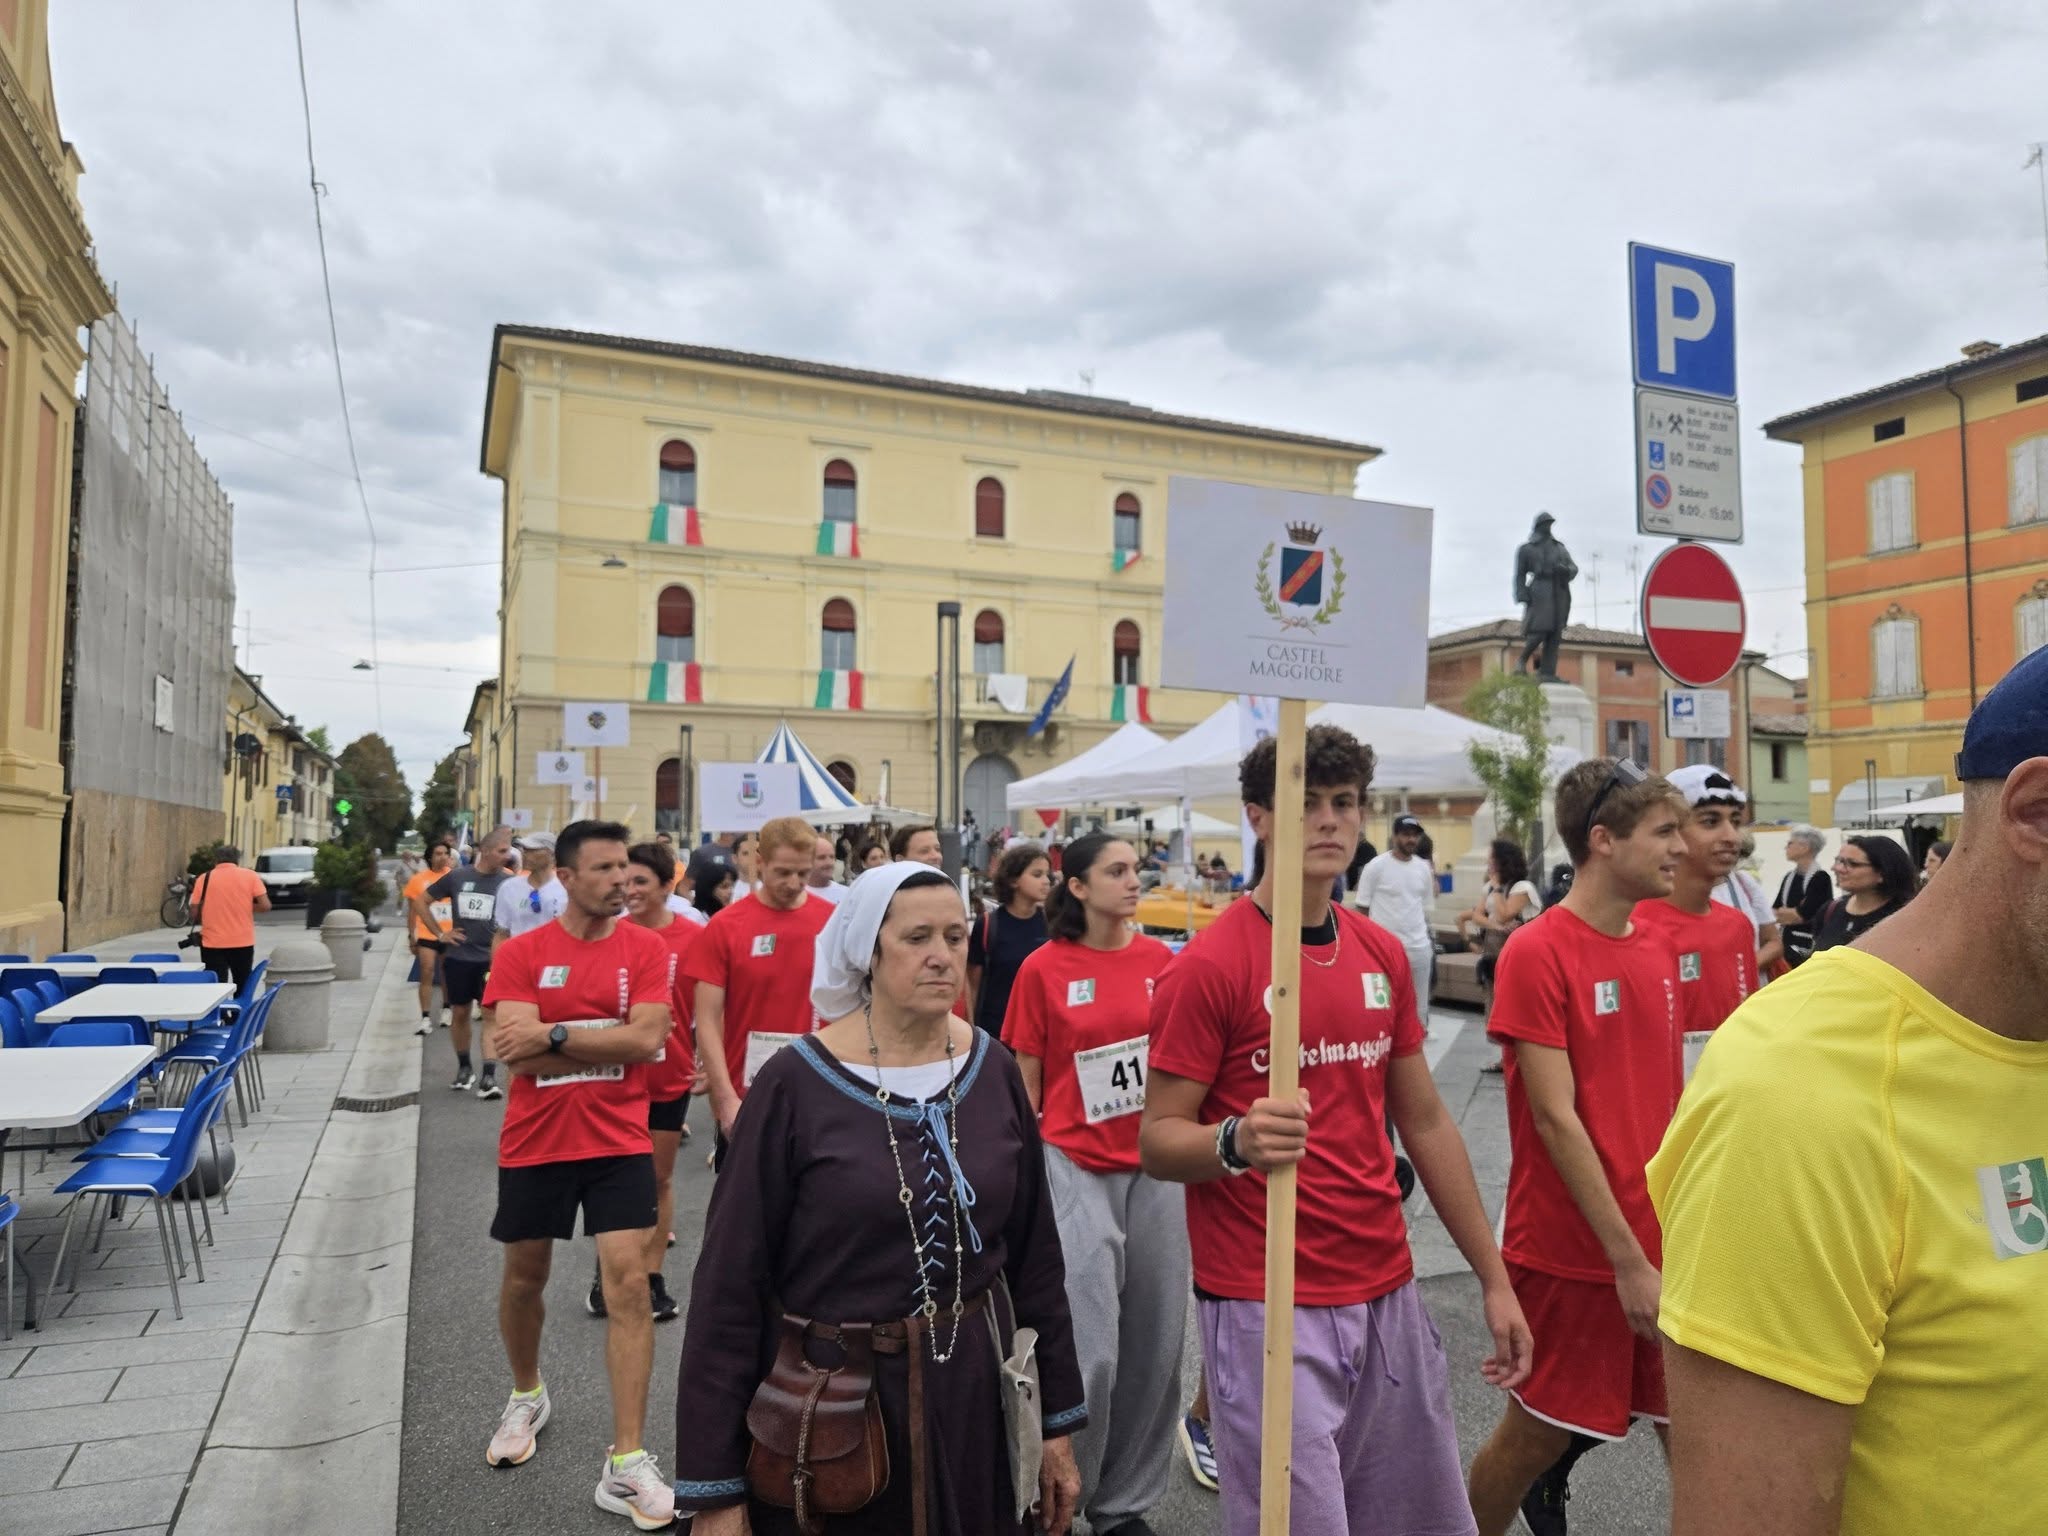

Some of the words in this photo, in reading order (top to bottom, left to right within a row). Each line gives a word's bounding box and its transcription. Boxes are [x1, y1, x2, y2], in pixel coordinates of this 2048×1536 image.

[1655, 261, 1717, 374] P
[1267, 643, 1328, 665] CASTEL
[1249, 660, 1343, 683] MAGGIORE
[1112, 1056, 1144, 1091] 41
